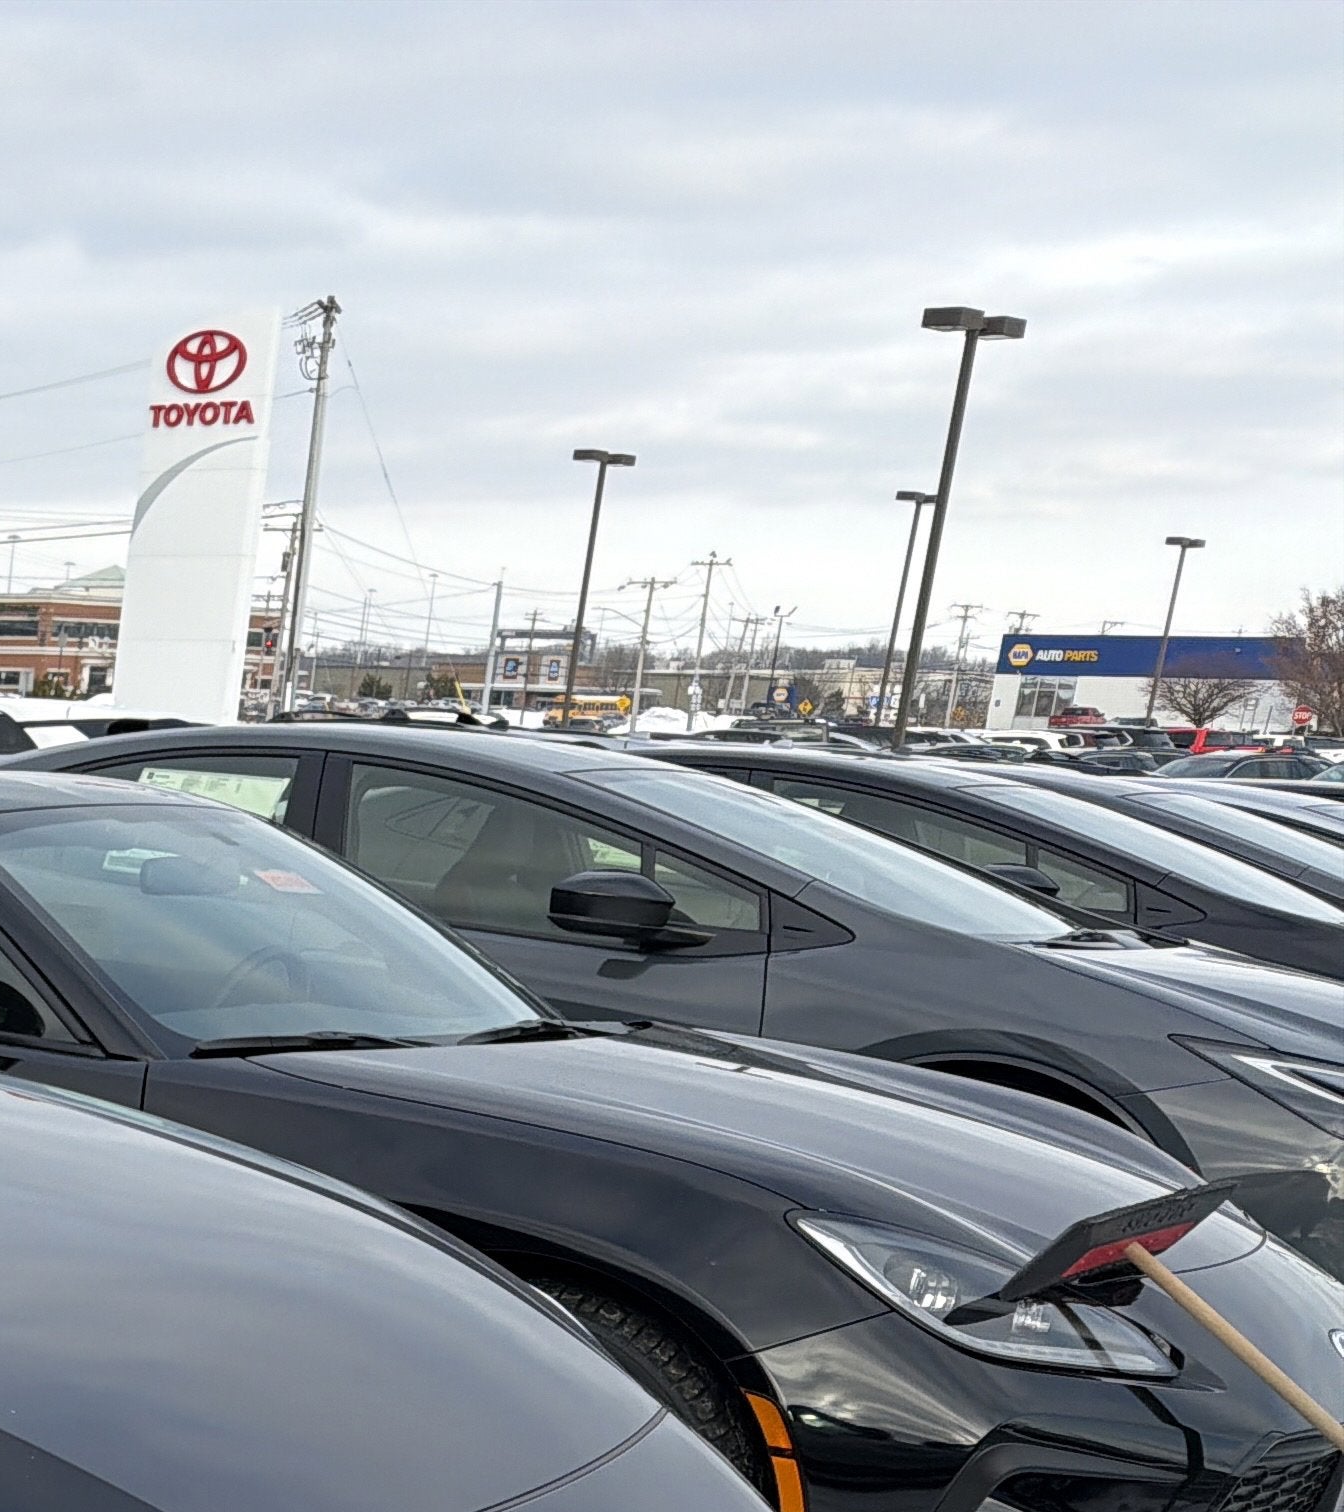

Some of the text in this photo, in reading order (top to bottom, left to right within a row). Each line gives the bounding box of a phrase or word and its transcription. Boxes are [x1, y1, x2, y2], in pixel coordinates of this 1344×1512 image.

[149, 399, 255, 429] TOYOTA
[1035, 649, 1064, 662] AUTO
[1064, 649, 1099, 662] PARTS
[1293, 711, 1312, 720] STOP
